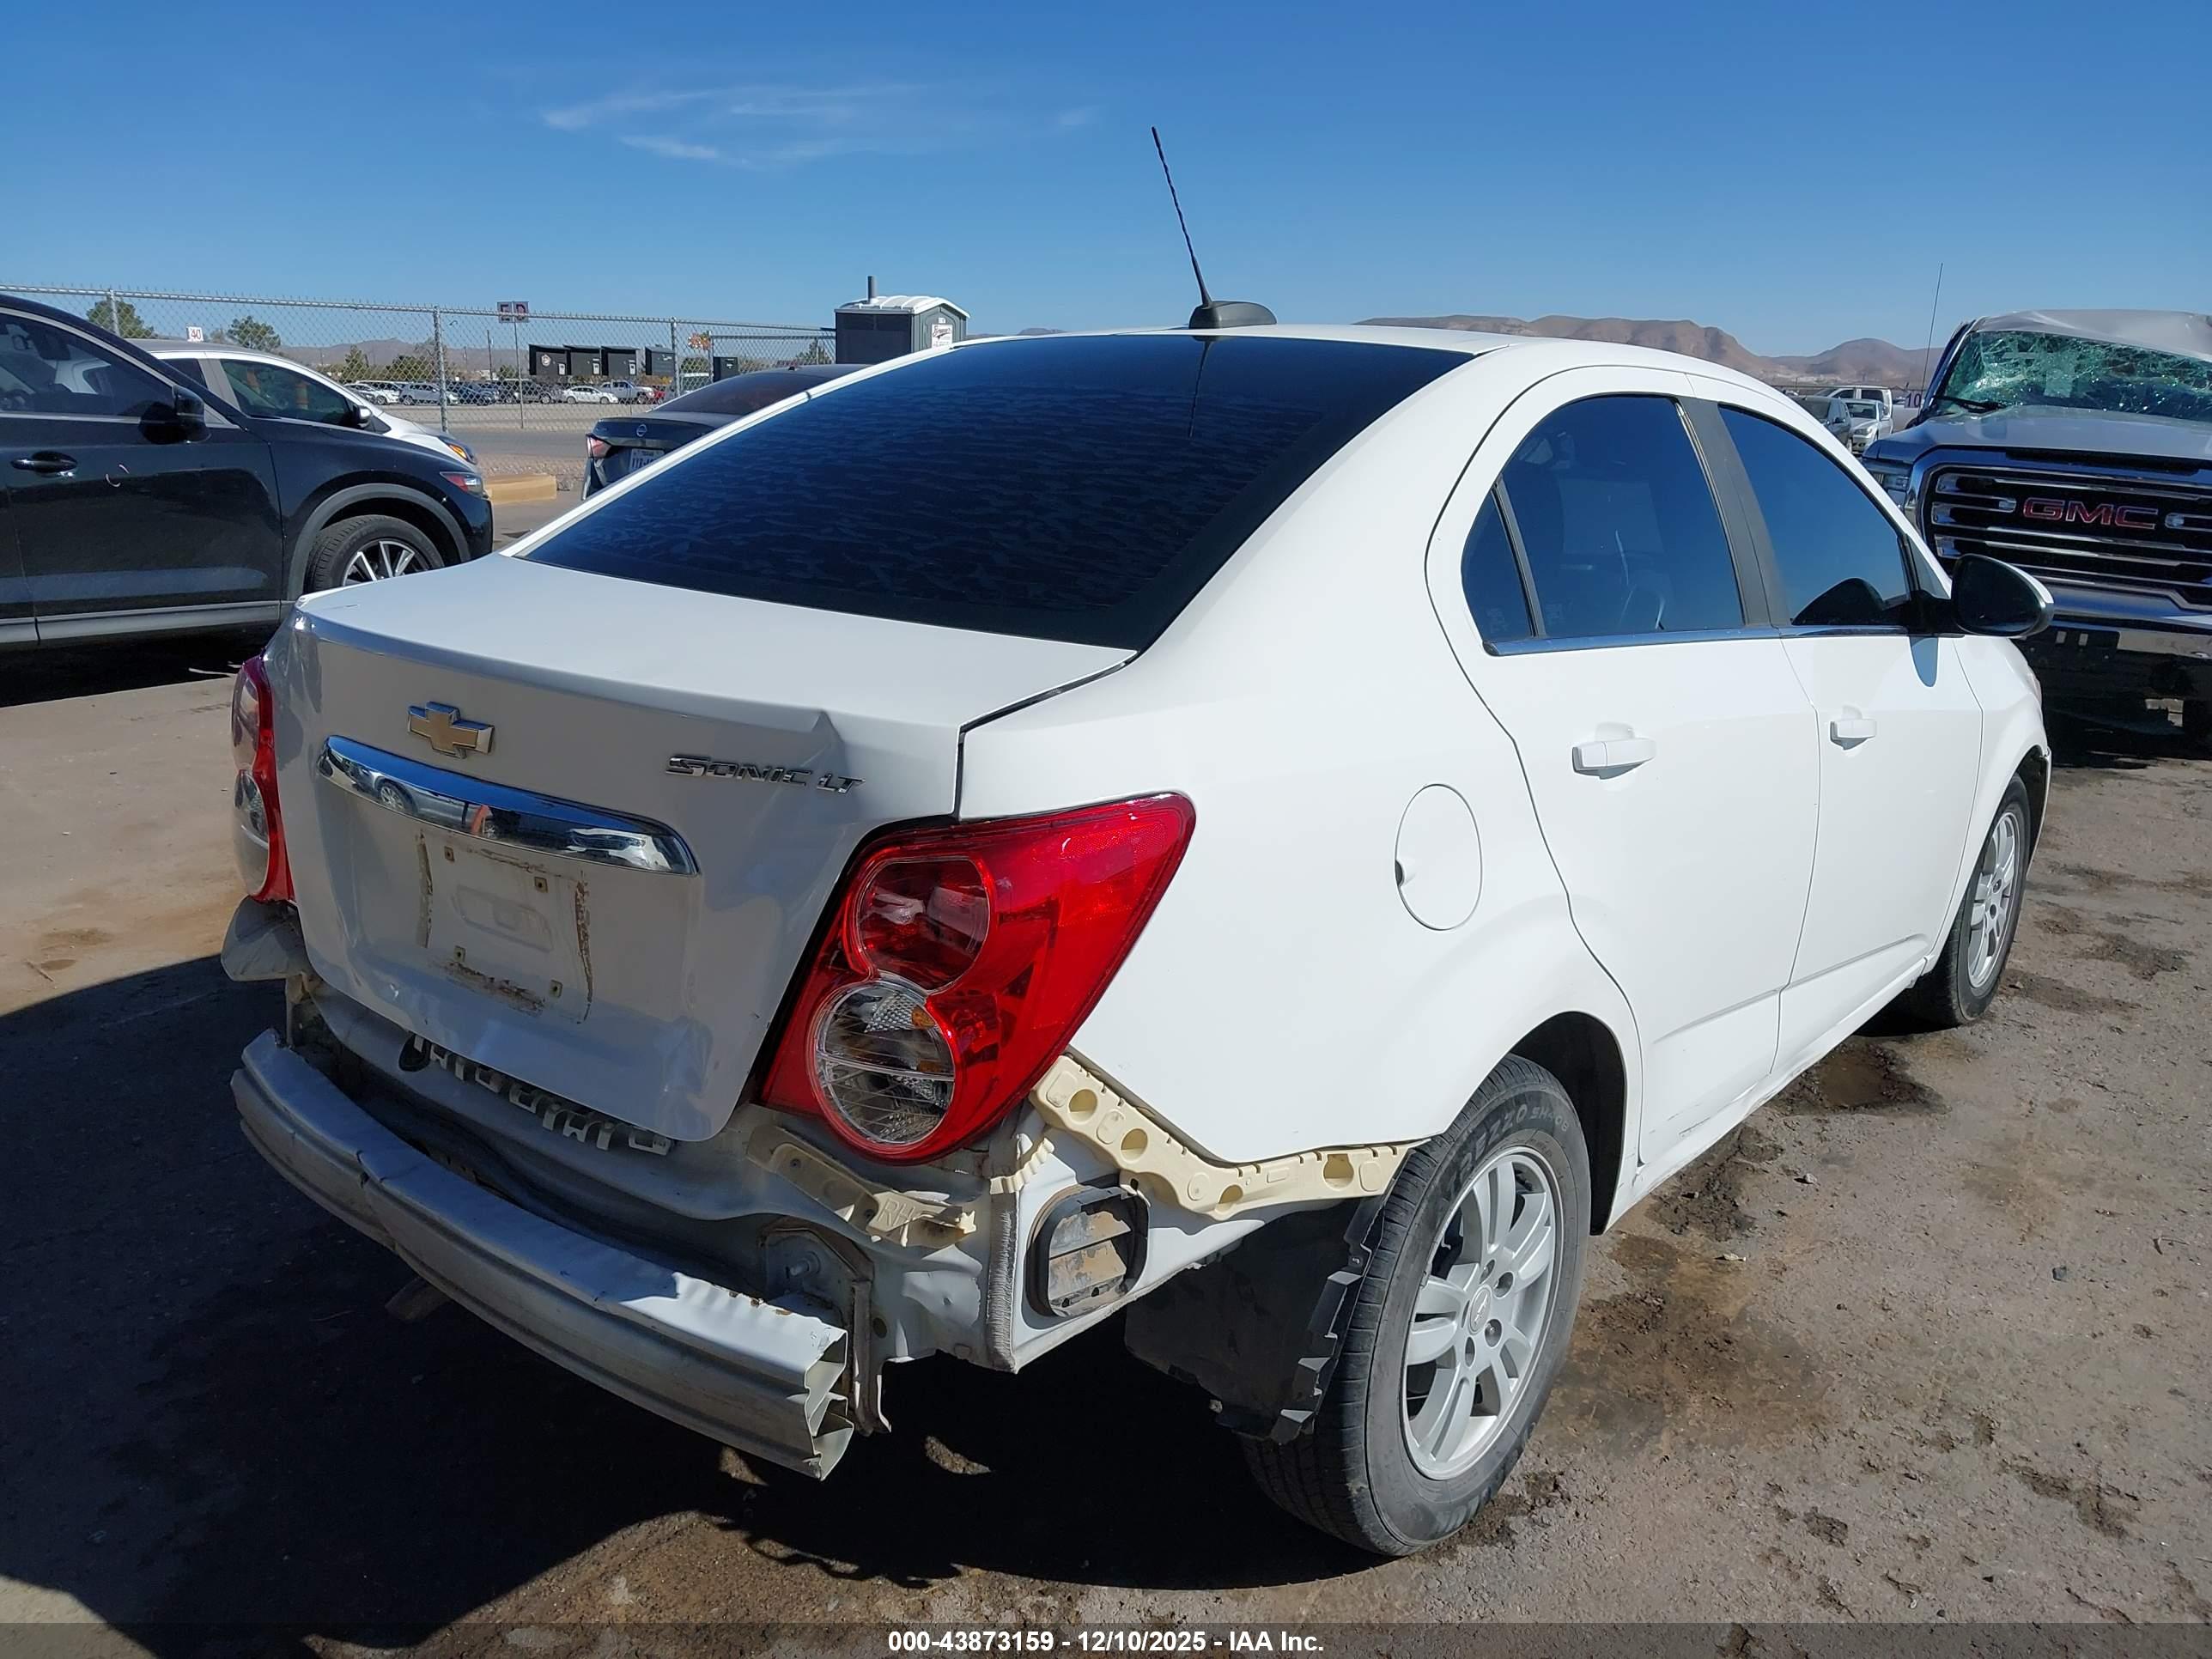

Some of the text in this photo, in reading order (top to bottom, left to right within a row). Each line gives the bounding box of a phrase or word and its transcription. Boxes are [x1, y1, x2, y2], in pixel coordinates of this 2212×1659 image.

[1906, 392, 1922, 408] 10
[2023, 497, 2159, 530] GMC
[666, 756, 866, 793] SONIC LT
